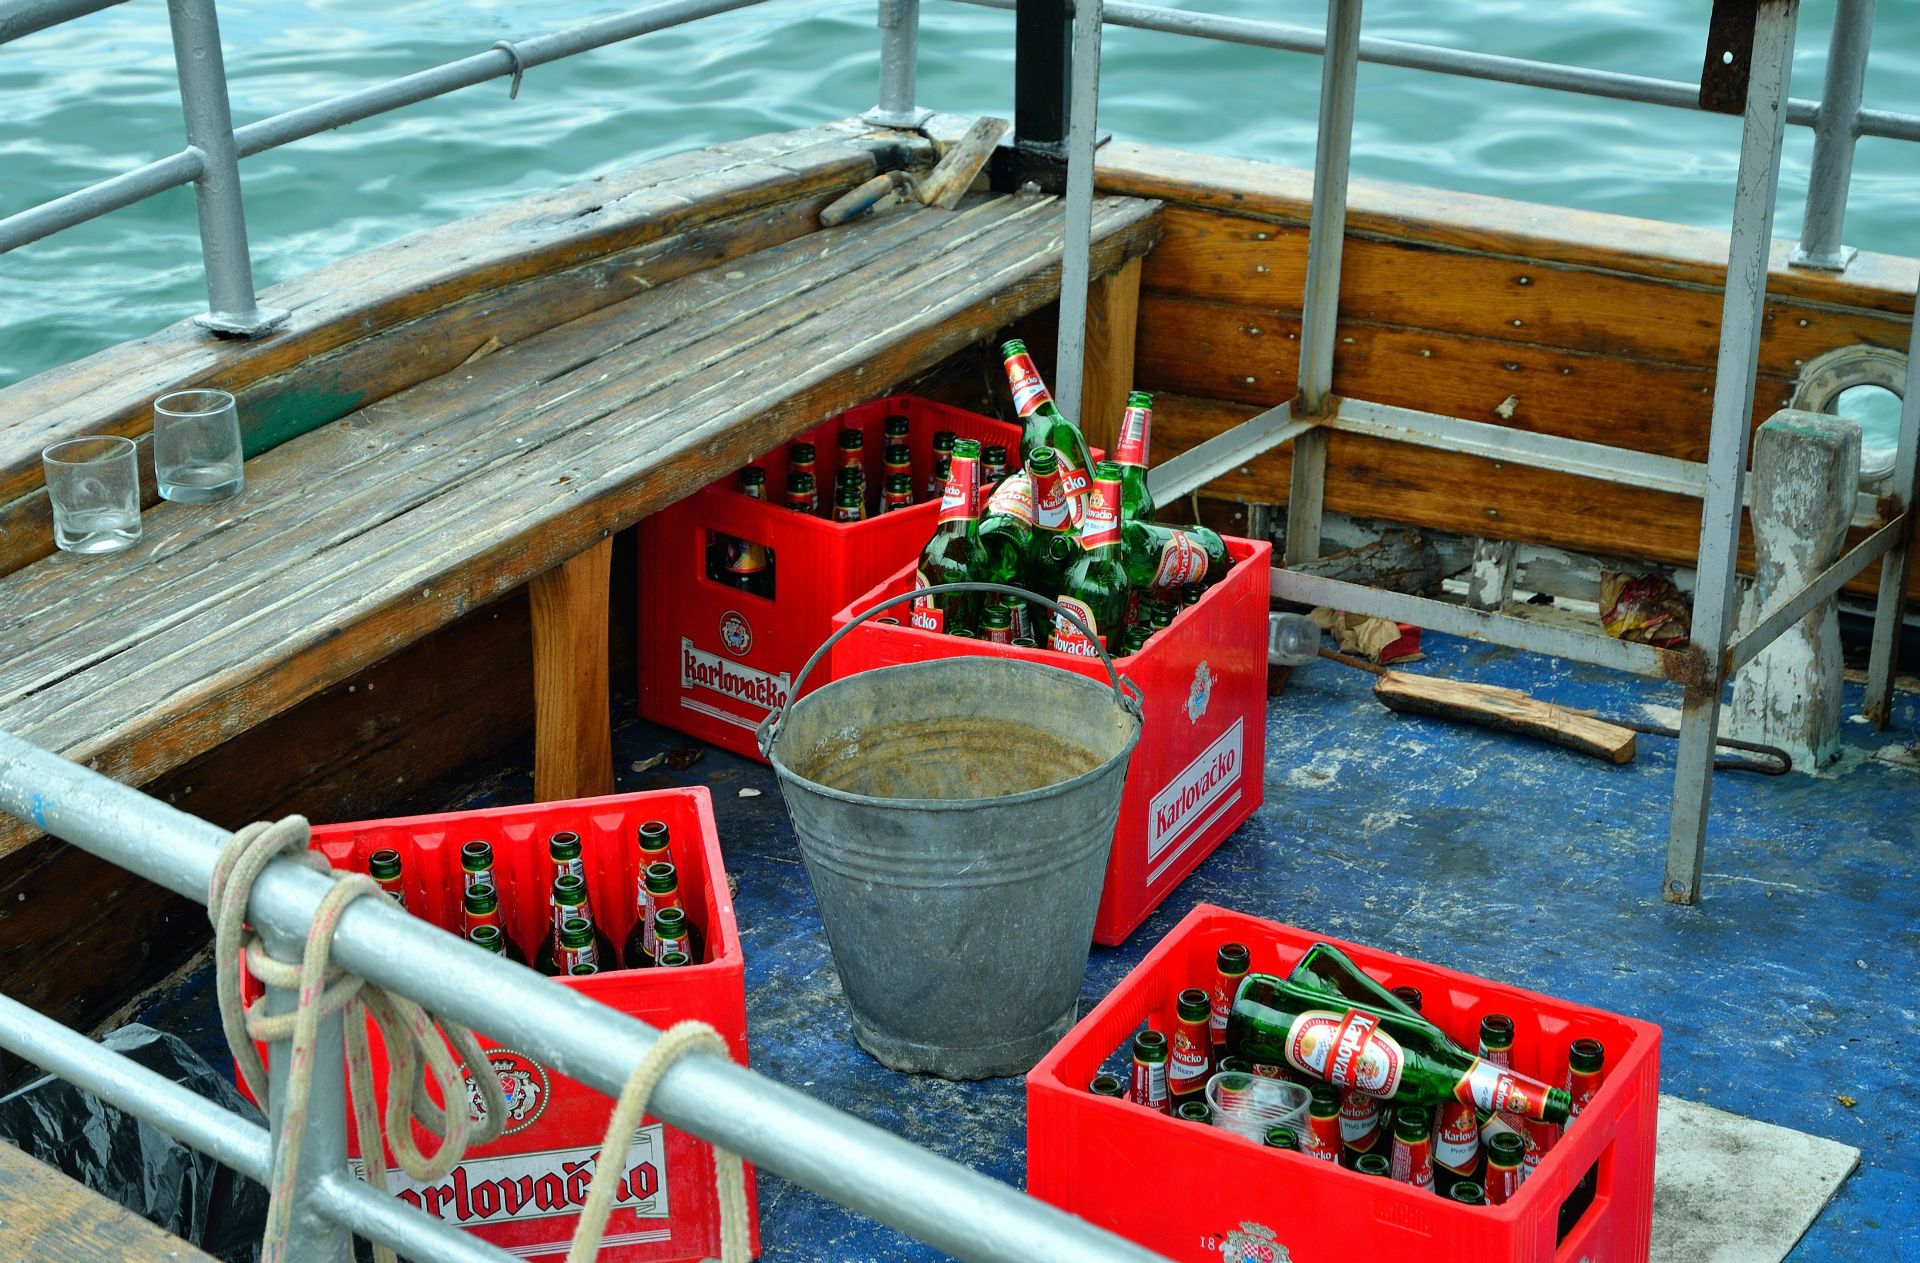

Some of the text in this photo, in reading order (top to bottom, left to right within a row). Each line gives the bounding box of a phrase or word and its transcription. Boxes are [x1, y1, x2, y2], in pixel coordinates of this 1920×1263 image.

[684, 649, 788, 711] Karlovačko
[1155, 748, 1236, 840] Karlovačko
[1201, 1236, 1216, 1251] 18
